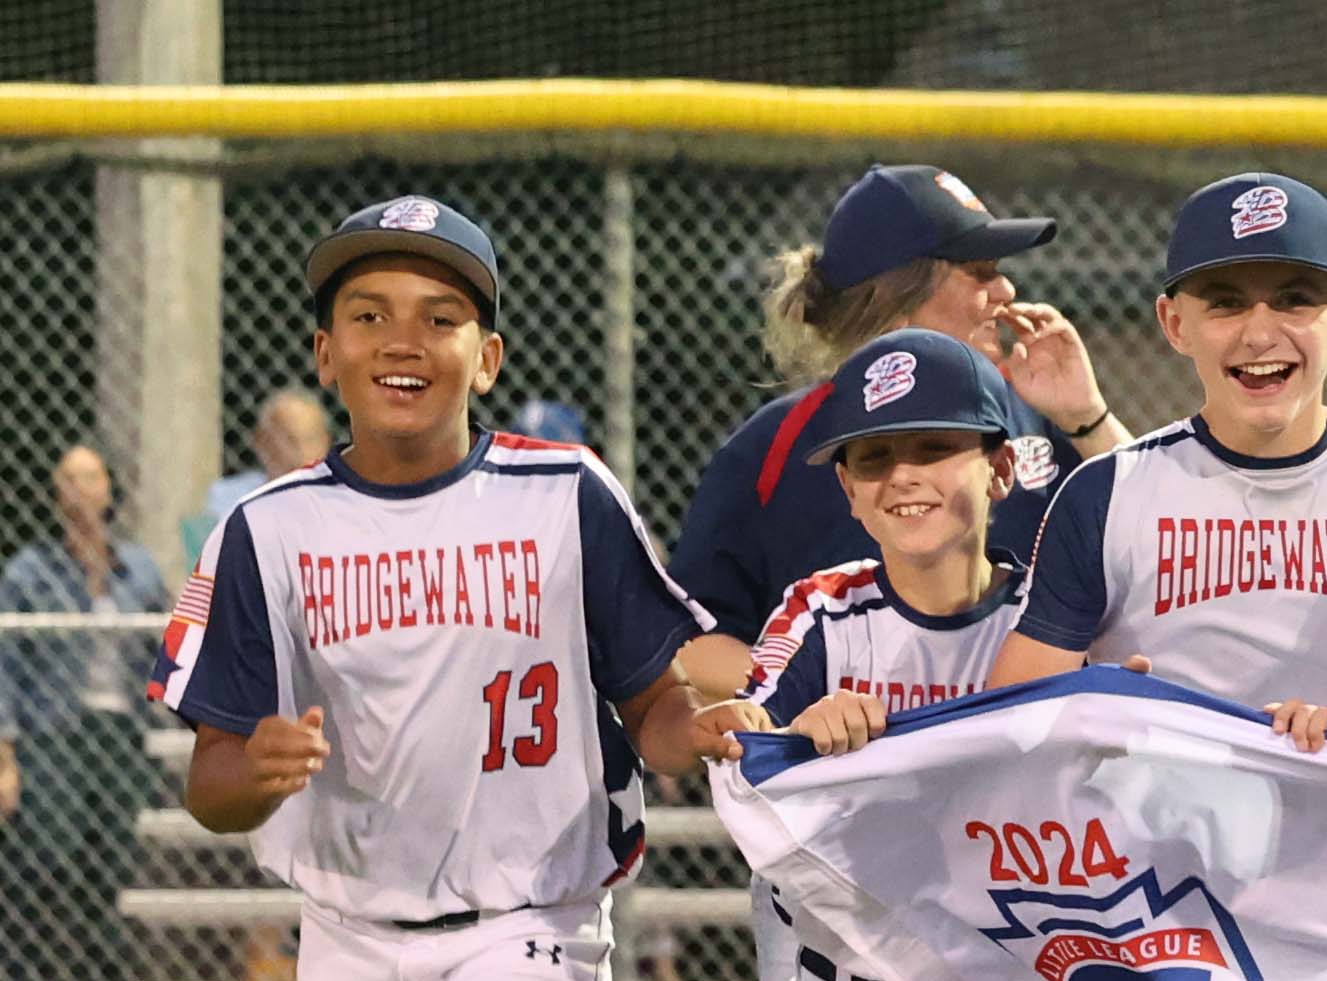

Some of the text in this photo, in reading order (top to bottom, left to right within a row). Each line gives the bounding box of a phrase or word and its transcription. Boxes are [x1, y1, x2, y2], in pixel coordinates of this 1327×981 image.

[298, 539, 541, 649] BRIDGEWATER
[481, 660, 558, 773] 13
[965, 818, 1130, 888] 2024
[1087, 934, 1203, 965] LEAGUE
